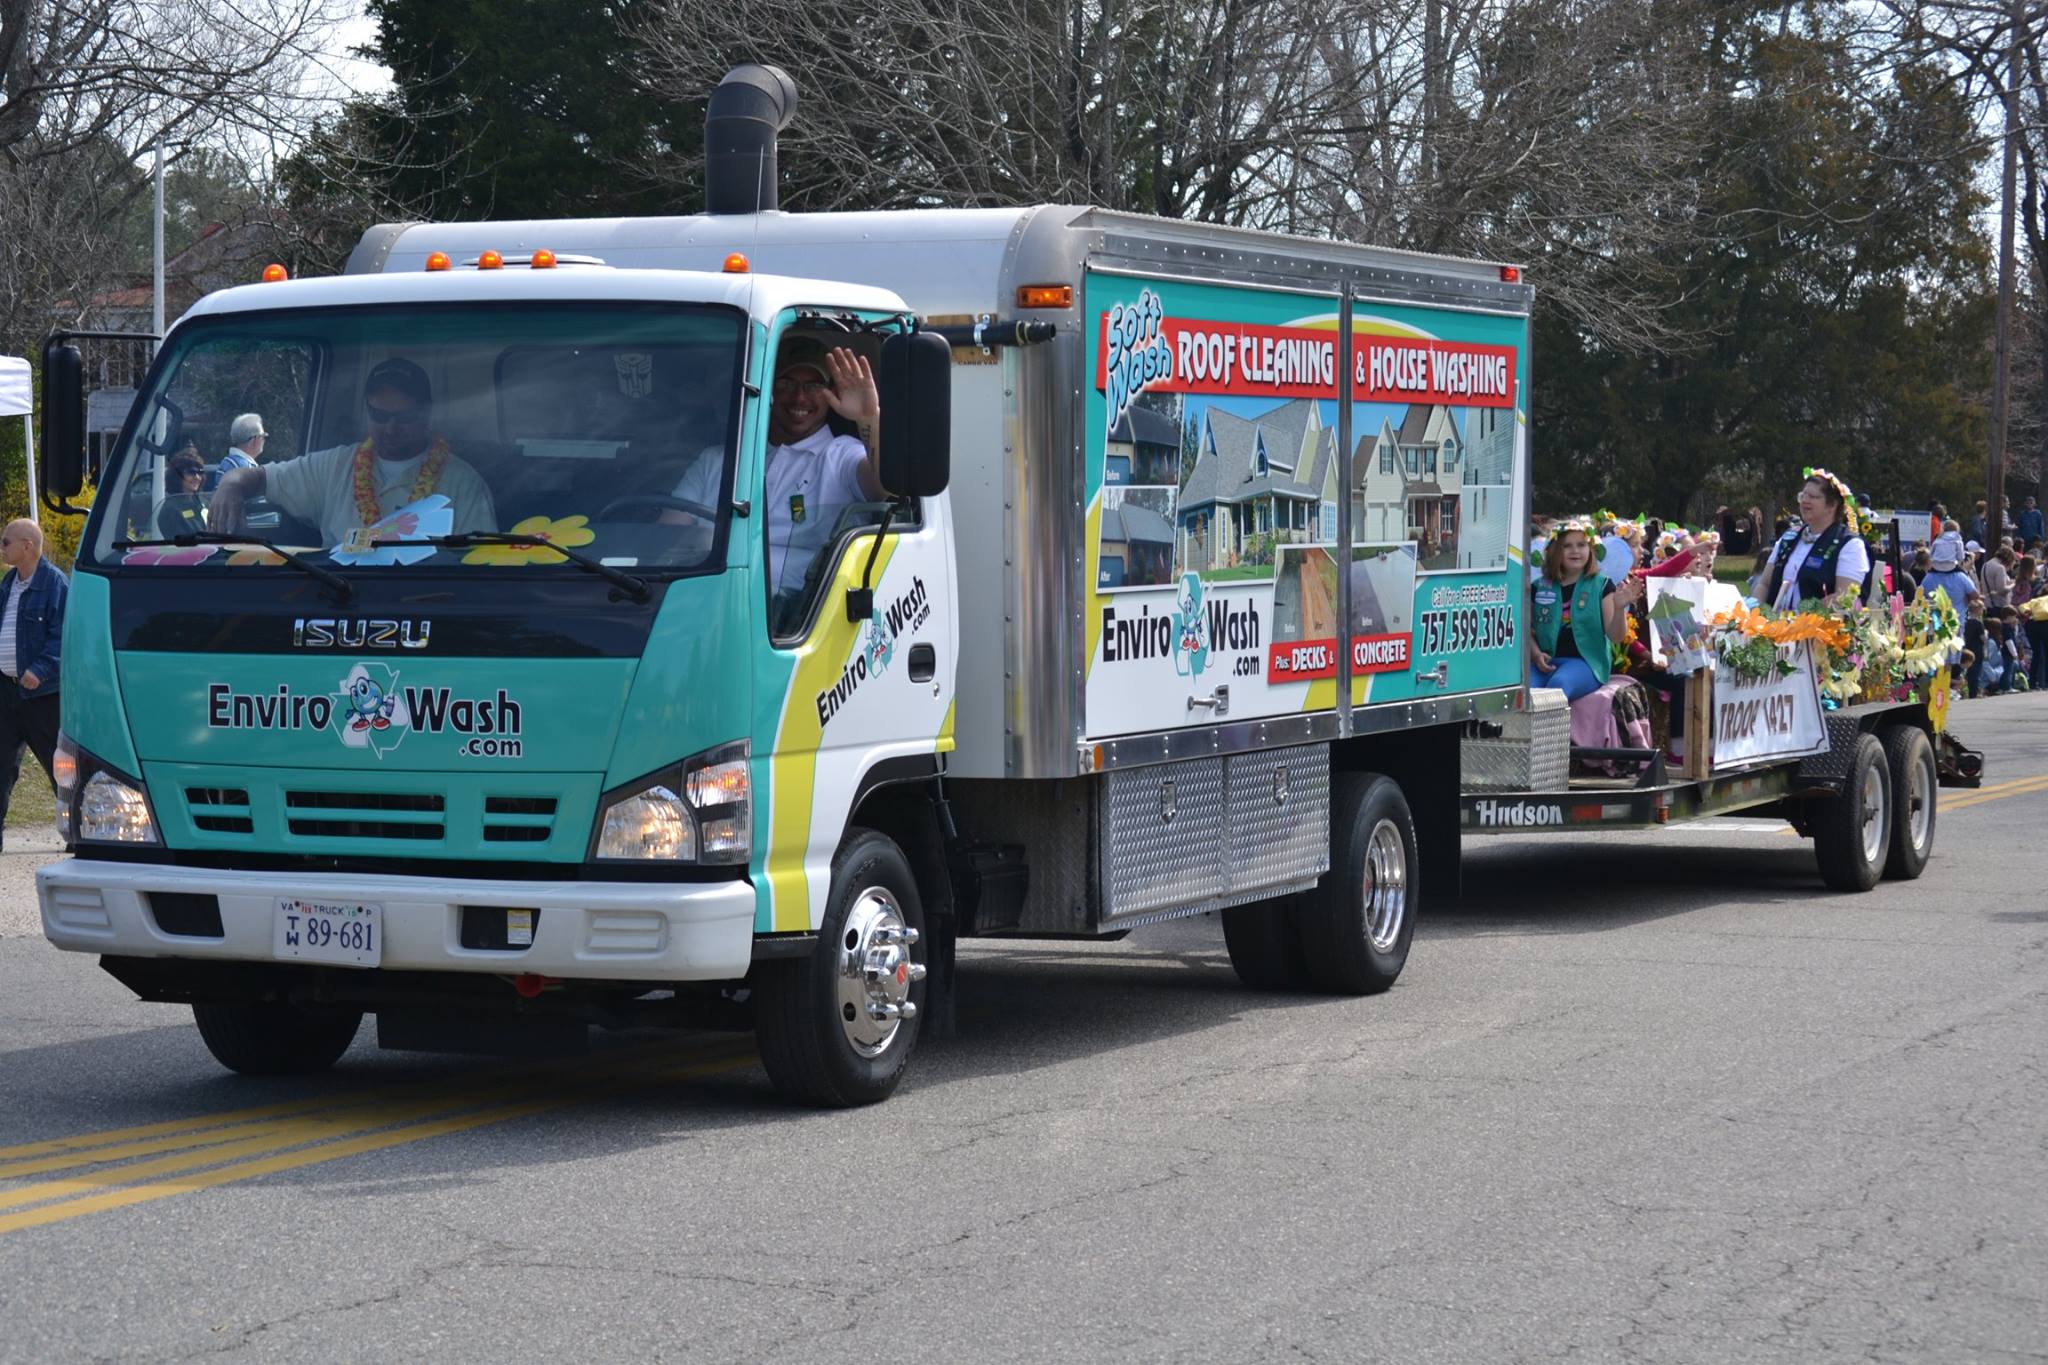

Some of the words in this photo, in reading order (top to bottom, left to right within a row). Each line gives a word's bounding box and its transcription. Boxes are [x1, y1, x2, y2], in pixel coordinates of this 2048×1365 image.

[1107, 290, 1162, 370] Soft
[1107, 335, 1172, 429] Wash
[1178, 330, 1237, 386] ROOF
[1239, 335, 1335, 388] CLEANING
[1355, 350, 1366, 385] &
[1370, 345, 1428, 393] HOUSE
[1430, 349, 1507, 397] WASHING
[885, 575, 927, 640] Wash
[1432, 586, 1445, 608] Call
[1461, 584, 1479, 606] FREE
[293, 618, 432, 649] ISUZU
[911, 603, 931, 635] .com
[1102, 603, 1172, 663] Enviro
[1208, 598, 1260, 650] Wash
[1421, 604, 1514, 656] 757.599.3164
[1232, 654, 1260, 676] .com
[1291, 645, 1327, 672] DECKS
[1354, 638, 1407, 666] CONCRETE
[208, 682, 332, 732] Enviro
[405, 686, 522, 736] Wash
[816, 654, 867, 728] Enviro
[1763, 693, 1794, 737] 1427
[458, 737, 523, 758] .com
[1475, 799, 1564, 827] Hudson
[281, 901, 295, 912] VA
[313, 904, 345, 916] TRUCK
[307, 917, 373, 952] 89-681
